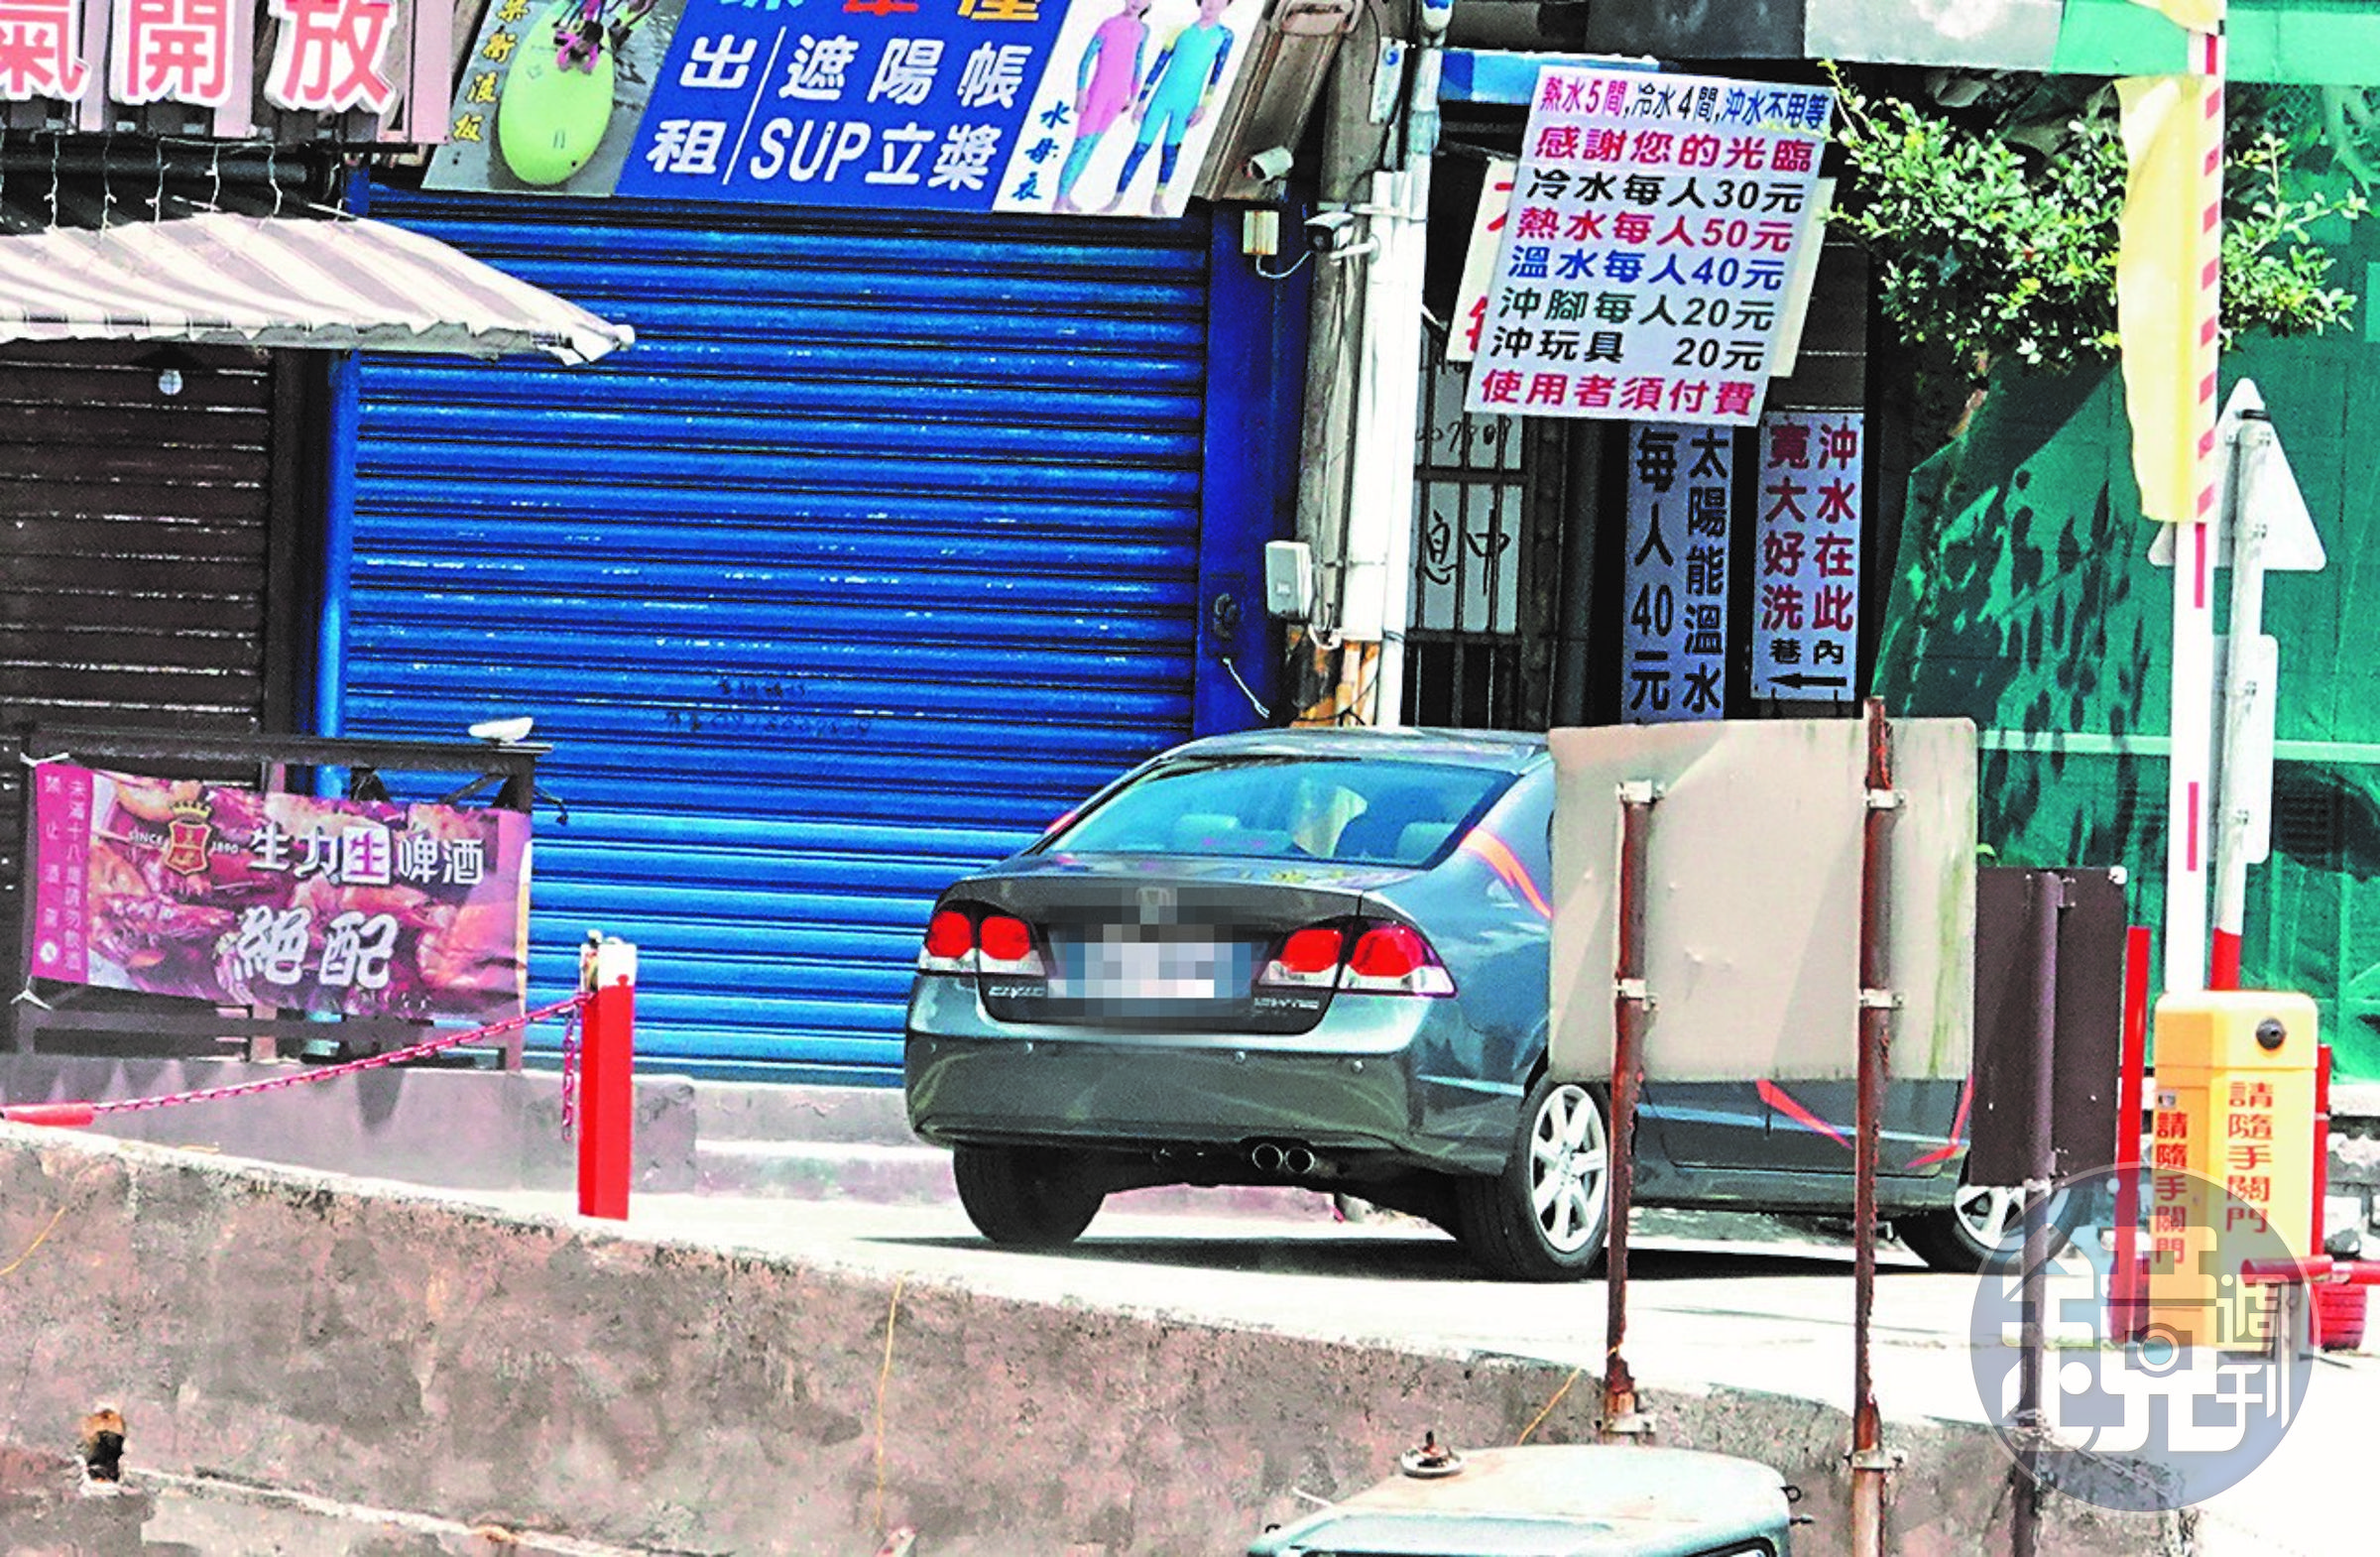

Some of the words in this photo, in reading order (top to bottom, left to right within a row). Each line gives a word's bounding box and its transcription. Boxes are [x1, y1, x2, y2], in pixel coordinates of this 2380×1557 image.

[647, 35, 758, 175] 出租
[778, 35, 1032, 108] 遮陽帳
[1535, 125, 1816, 173] 感謝您的光臨
[1527, 168, 1805, 213] 冷水每人30元
[1516, 207, 1793, 253] 熱水每人50元
[1507, 245, 1785, 292] 溫水每人40元
[1498, 287, 1775, 331] 沖腳每人20元
[1490, 326, 1624, 364] 沖玩具
[1672, 337, 1765, 372] 20元
[1482, 369, 1755, 416] 使用者須付費
[1761, 422, 1811, 632] 寬大好洗
[1812, 421, 1857, 632] 沖水在此
[1630, 426, 1680, 712] 每人40元
[1682, 427, 1729, 714] 太陽能溫水
[248, 822, 485, 885] 生力生啤酒
[235, 904, 400, 989] 絕配
[2156, 1112, 2188, 1264] 請隨手關門
[2226, 1081, 2274, 1233] 請隨手關門
